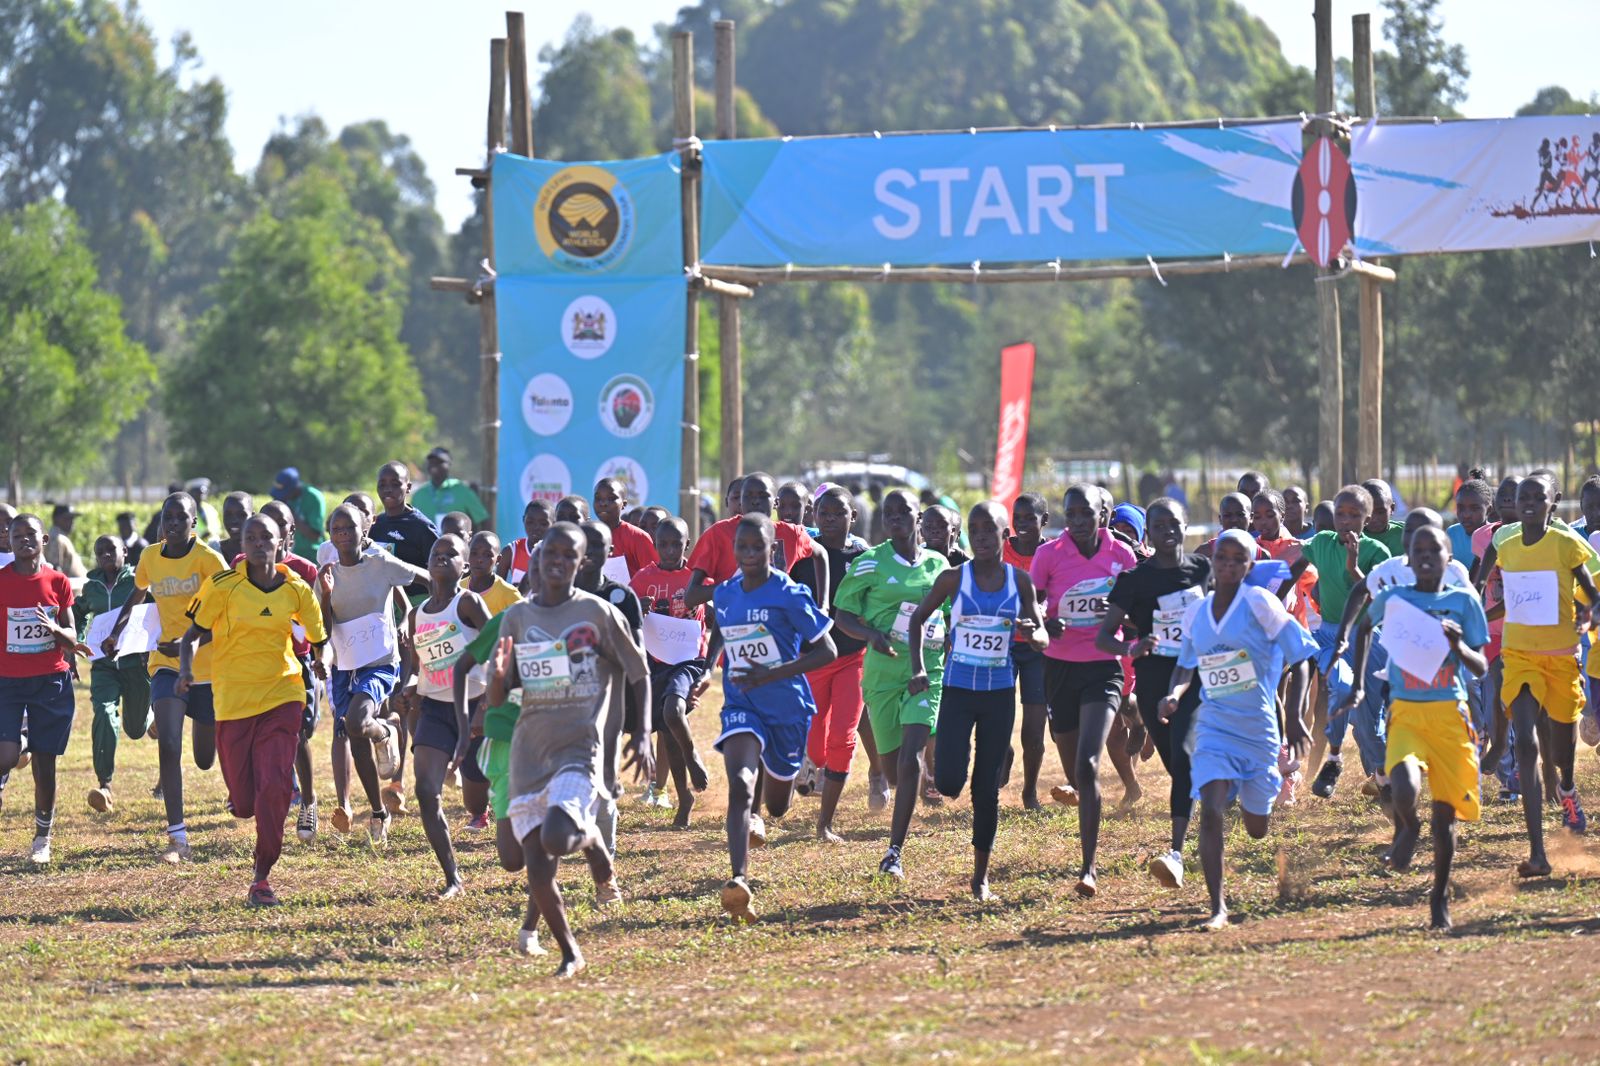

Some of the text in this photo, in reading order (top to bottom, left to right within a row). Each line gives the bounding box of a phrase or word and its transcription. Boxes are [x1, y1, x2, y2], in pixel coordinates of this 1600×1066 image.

[872, 164, 1124, 240] START
[562, 238, 608, 247] ATHLETICS
[746, 609, 769, 621] 156
[427, 641, 454, 660] 178
[963, 632, 1004, 651] 1252
[730, 641, 769, 662] 1420
[520, 660, 552, 678] 095
[1208, 667, 1240, 686] 093
[724, 711, 746, 727] 156
